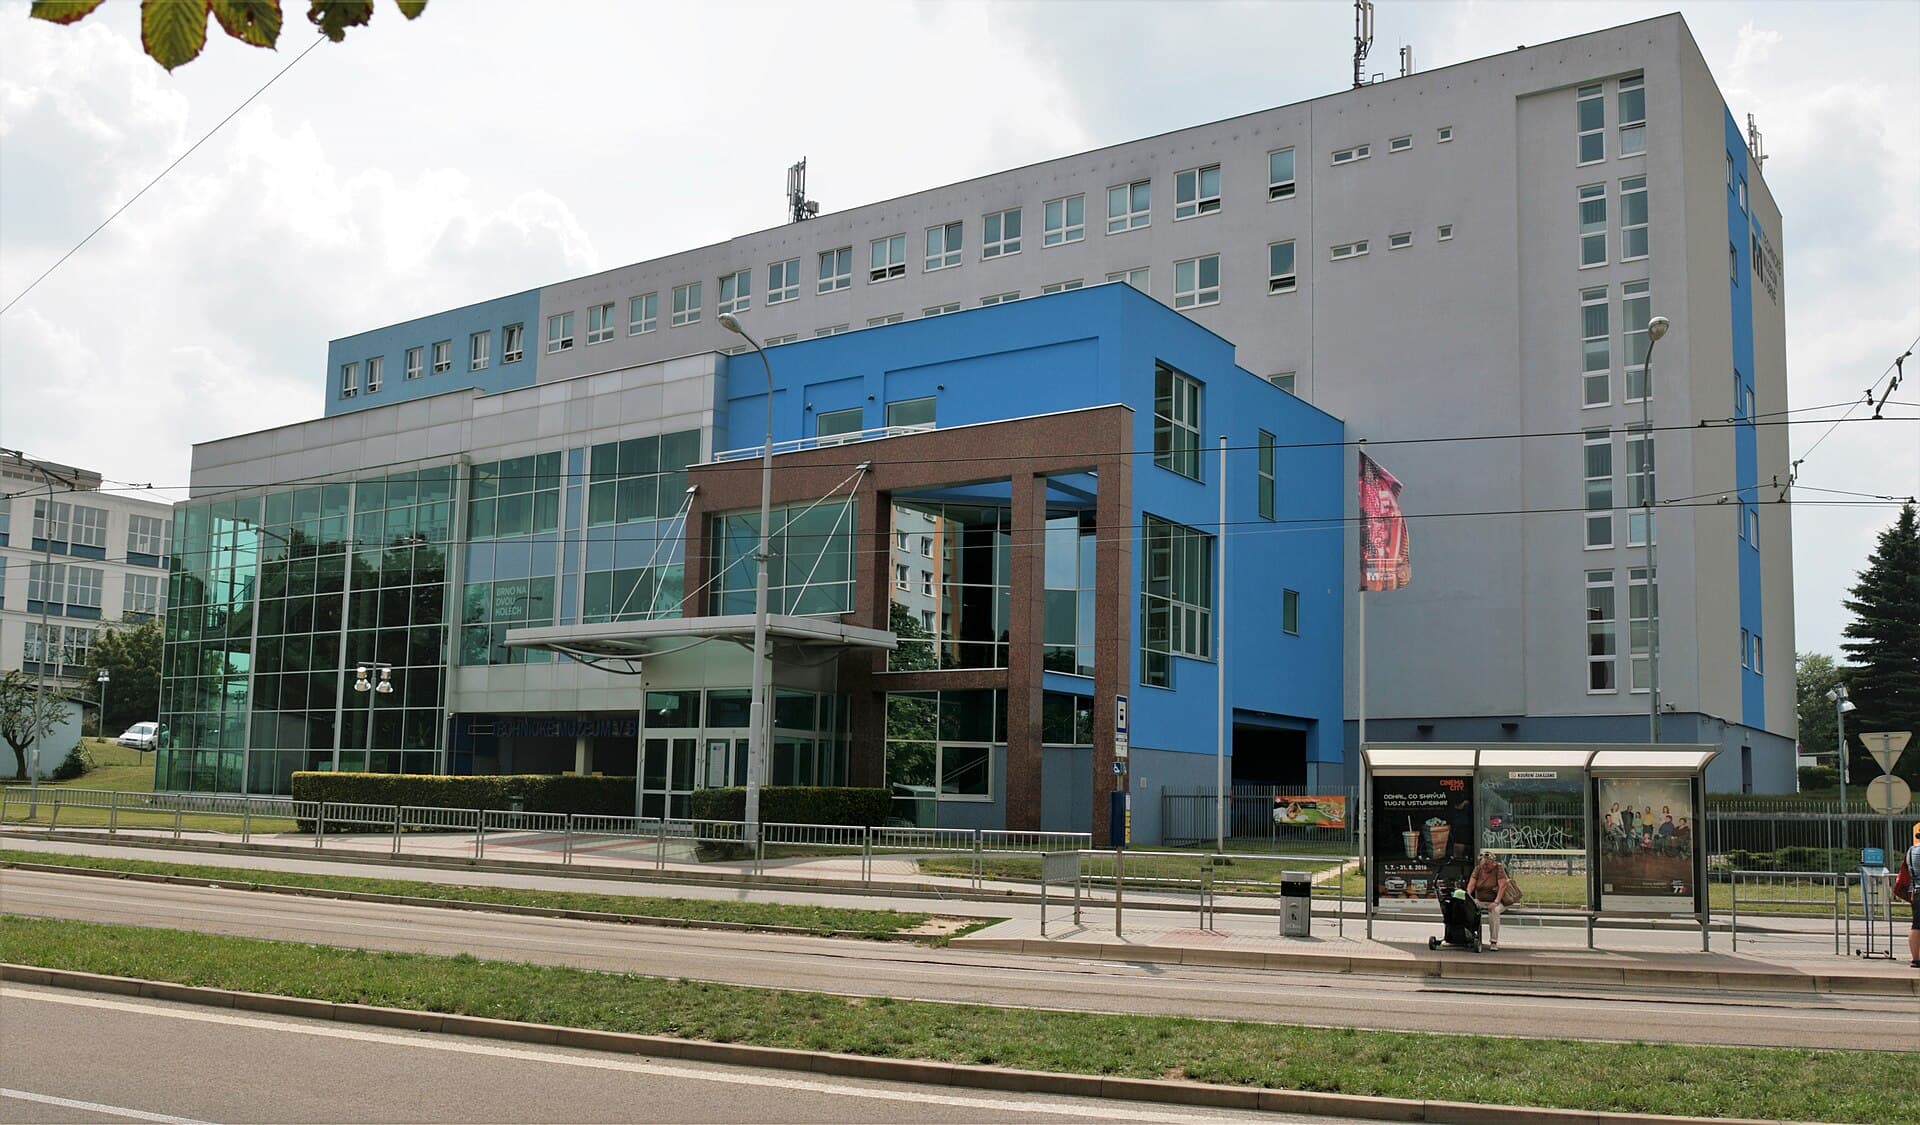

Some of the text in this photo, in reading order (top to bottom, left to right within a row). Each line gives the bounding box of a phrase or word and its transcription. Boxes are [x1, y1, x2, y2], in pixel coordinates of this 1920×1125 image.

[496, 585, 527, 597] BRNO NA
[496, 597, 516, 606] DVOU
[496, 606, 522, 616] KOLECH
